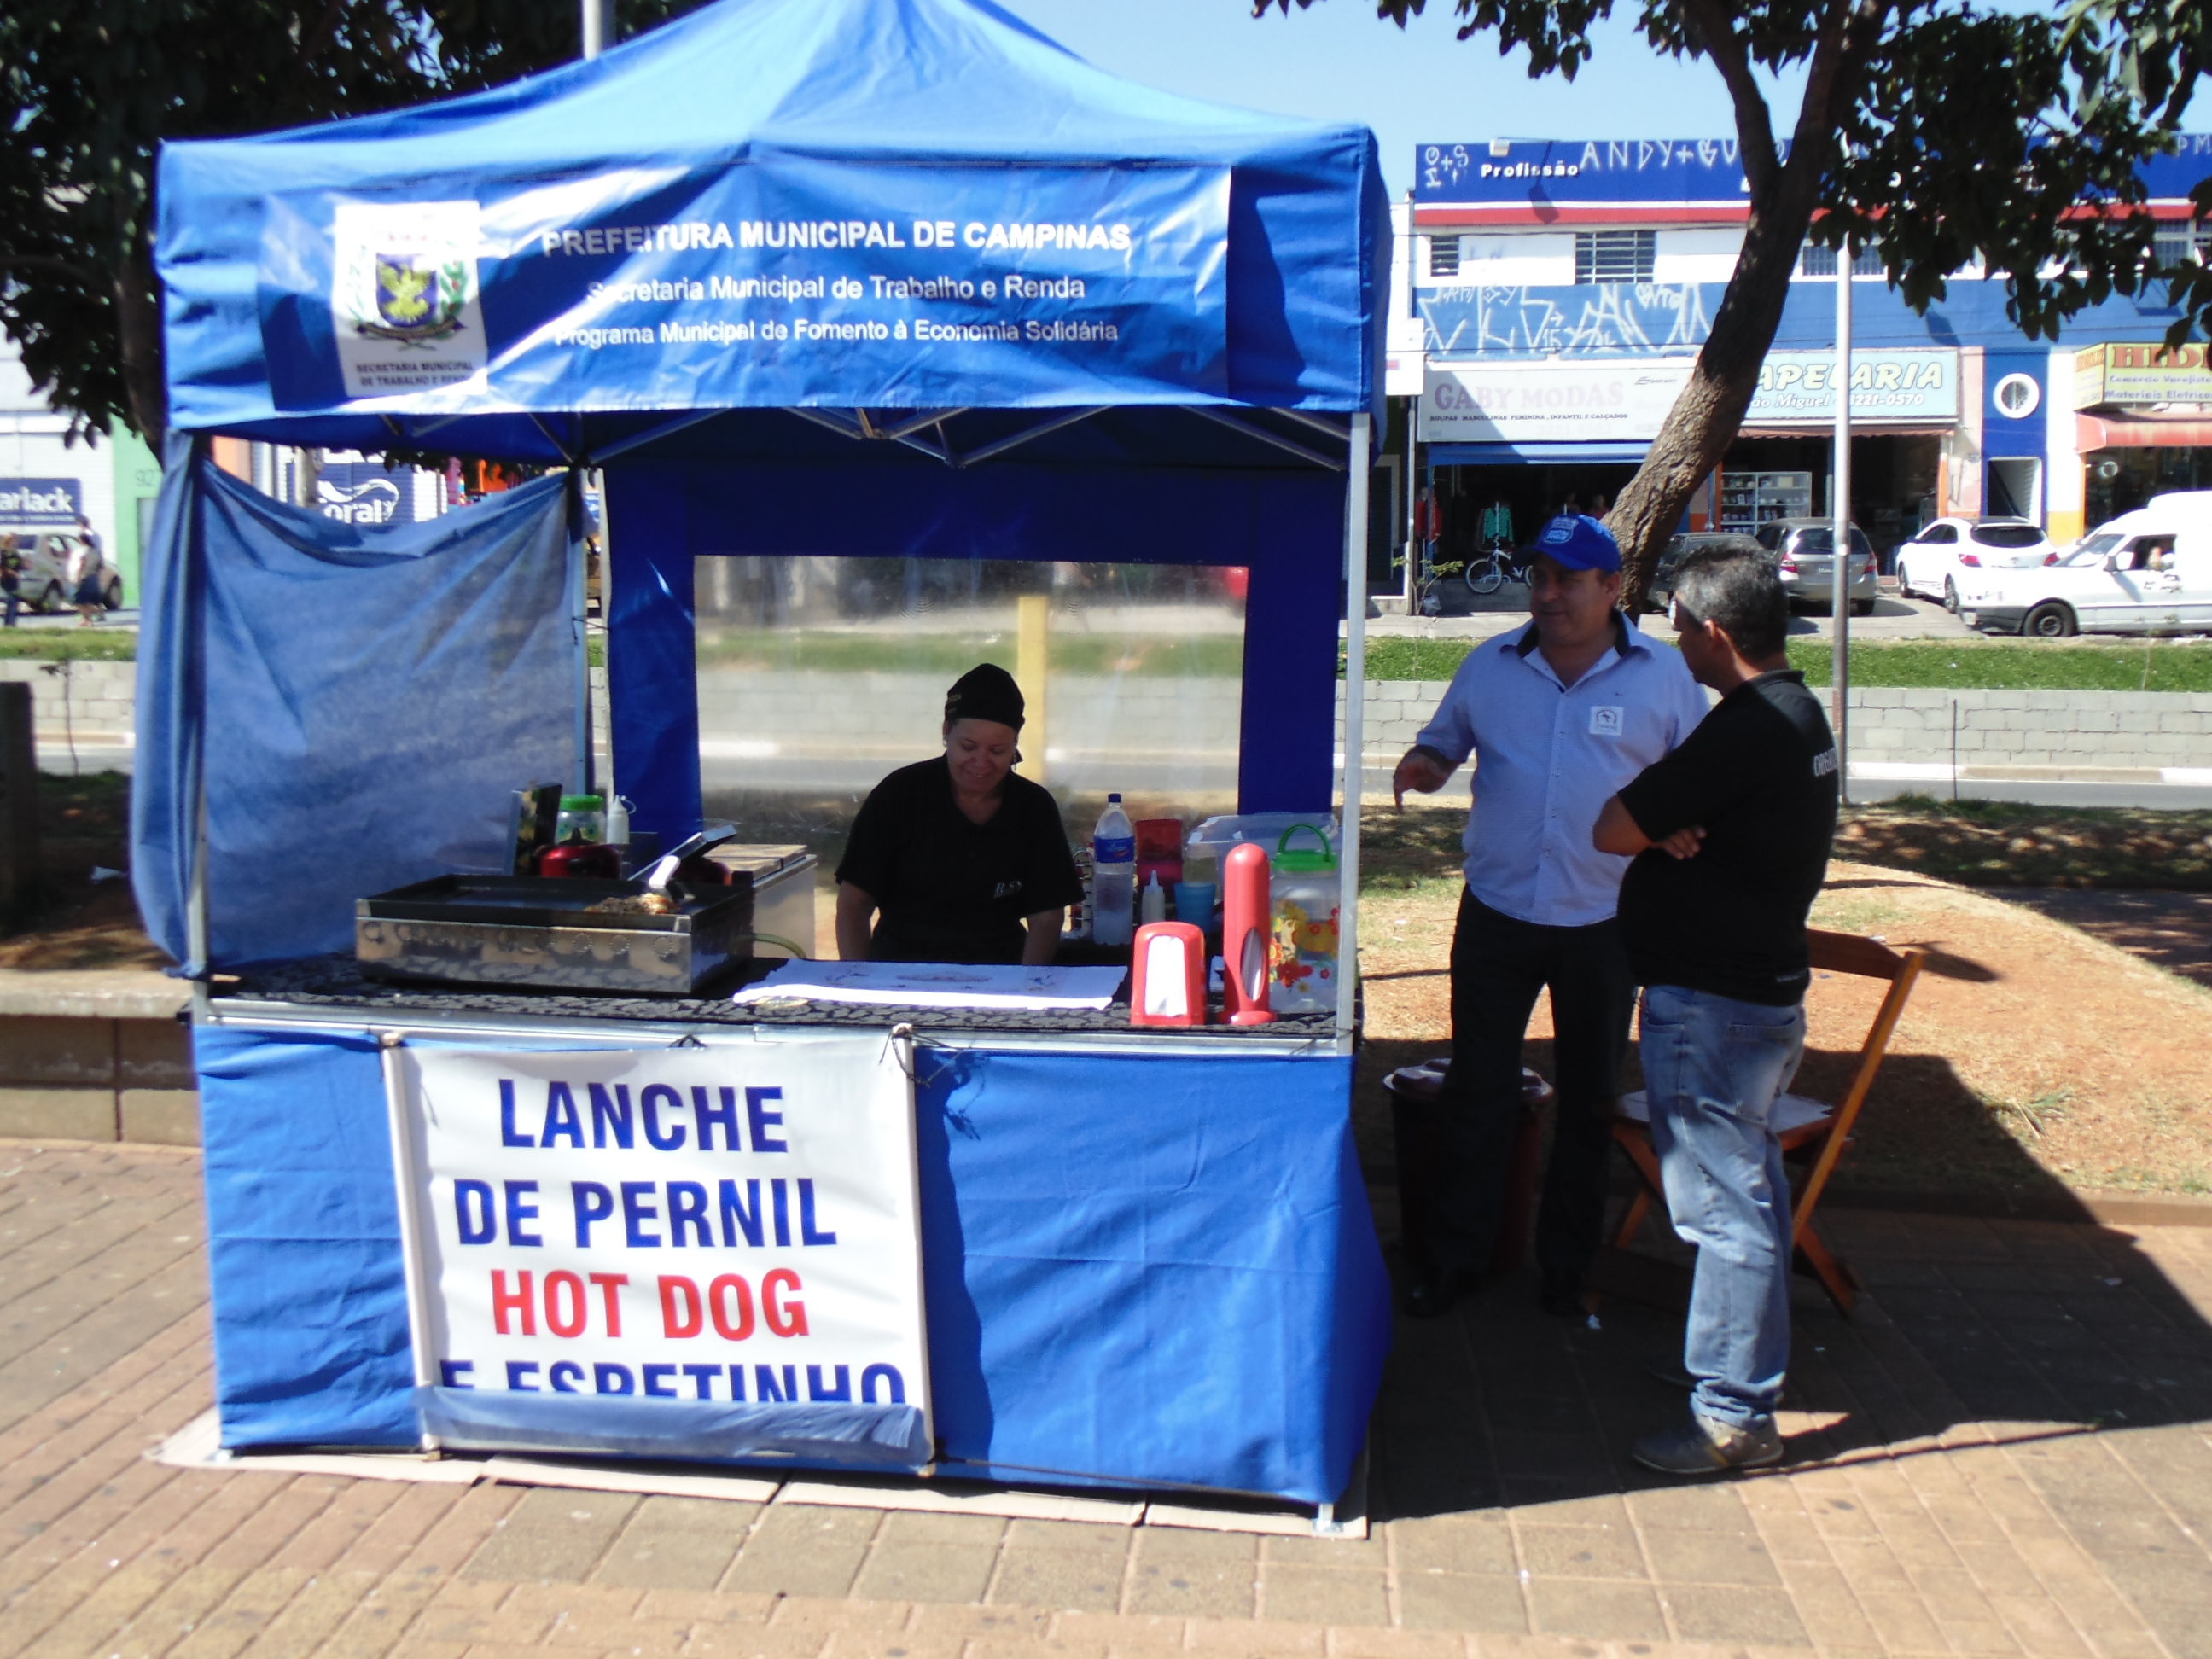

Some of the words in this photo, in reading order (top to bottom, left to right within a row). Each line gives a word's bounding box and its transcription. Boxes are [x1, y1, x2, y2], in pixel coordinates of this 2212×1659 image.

[1481, 160, 1578, 178] Profissão
[543, 222, 733, 257] PREFEITURA
[741, 221, 904, 248] MUNICIPAL
[914, 222, 954, 247] DE
[964, 222, 1130, 251] CAMPINAS
[710, 275, 824, 302] Municipal
[832, 276, 863, 299] de
[870, 275, 974, 300] Trabalho
[981, 282, 997, 300] e
[1004, 275, 1085, 299] Renda
[556, 327, 655, 350] Programa
[660, 320, 754, 345] Municipal
[761, 319, 788, 340] de
[795, 319, 888, 341] Fomento
[894, 318, 907, 340] à
[915, 320, 1019, 341] Economia
[1025, 320, 1118, 341] Solidária
[356, 361, 418, 373] SECRETARIA
[421, 360, 474, 371] MUNICIPAL
[361, 376, 373, 387] DE
[378, 375, 430, 386] TRABALHO
[1759, 362, 1942, 392] APEARIA
[1435, 383, 1513, 410] GABY
[1522, 381, 1624, 409] MODAS
[1774, 393, 1831, 410] Miguel
[319, 497, 383, 523] oral
[499, 1079, 787, 1152] LANCHE
[454, 1179, 544, 1247] DE
[570, 1178, 837, 1248] PERNIL
[490, 1268, 630, 1338] HOT
[657, 1267, 809, 1342] DOG
